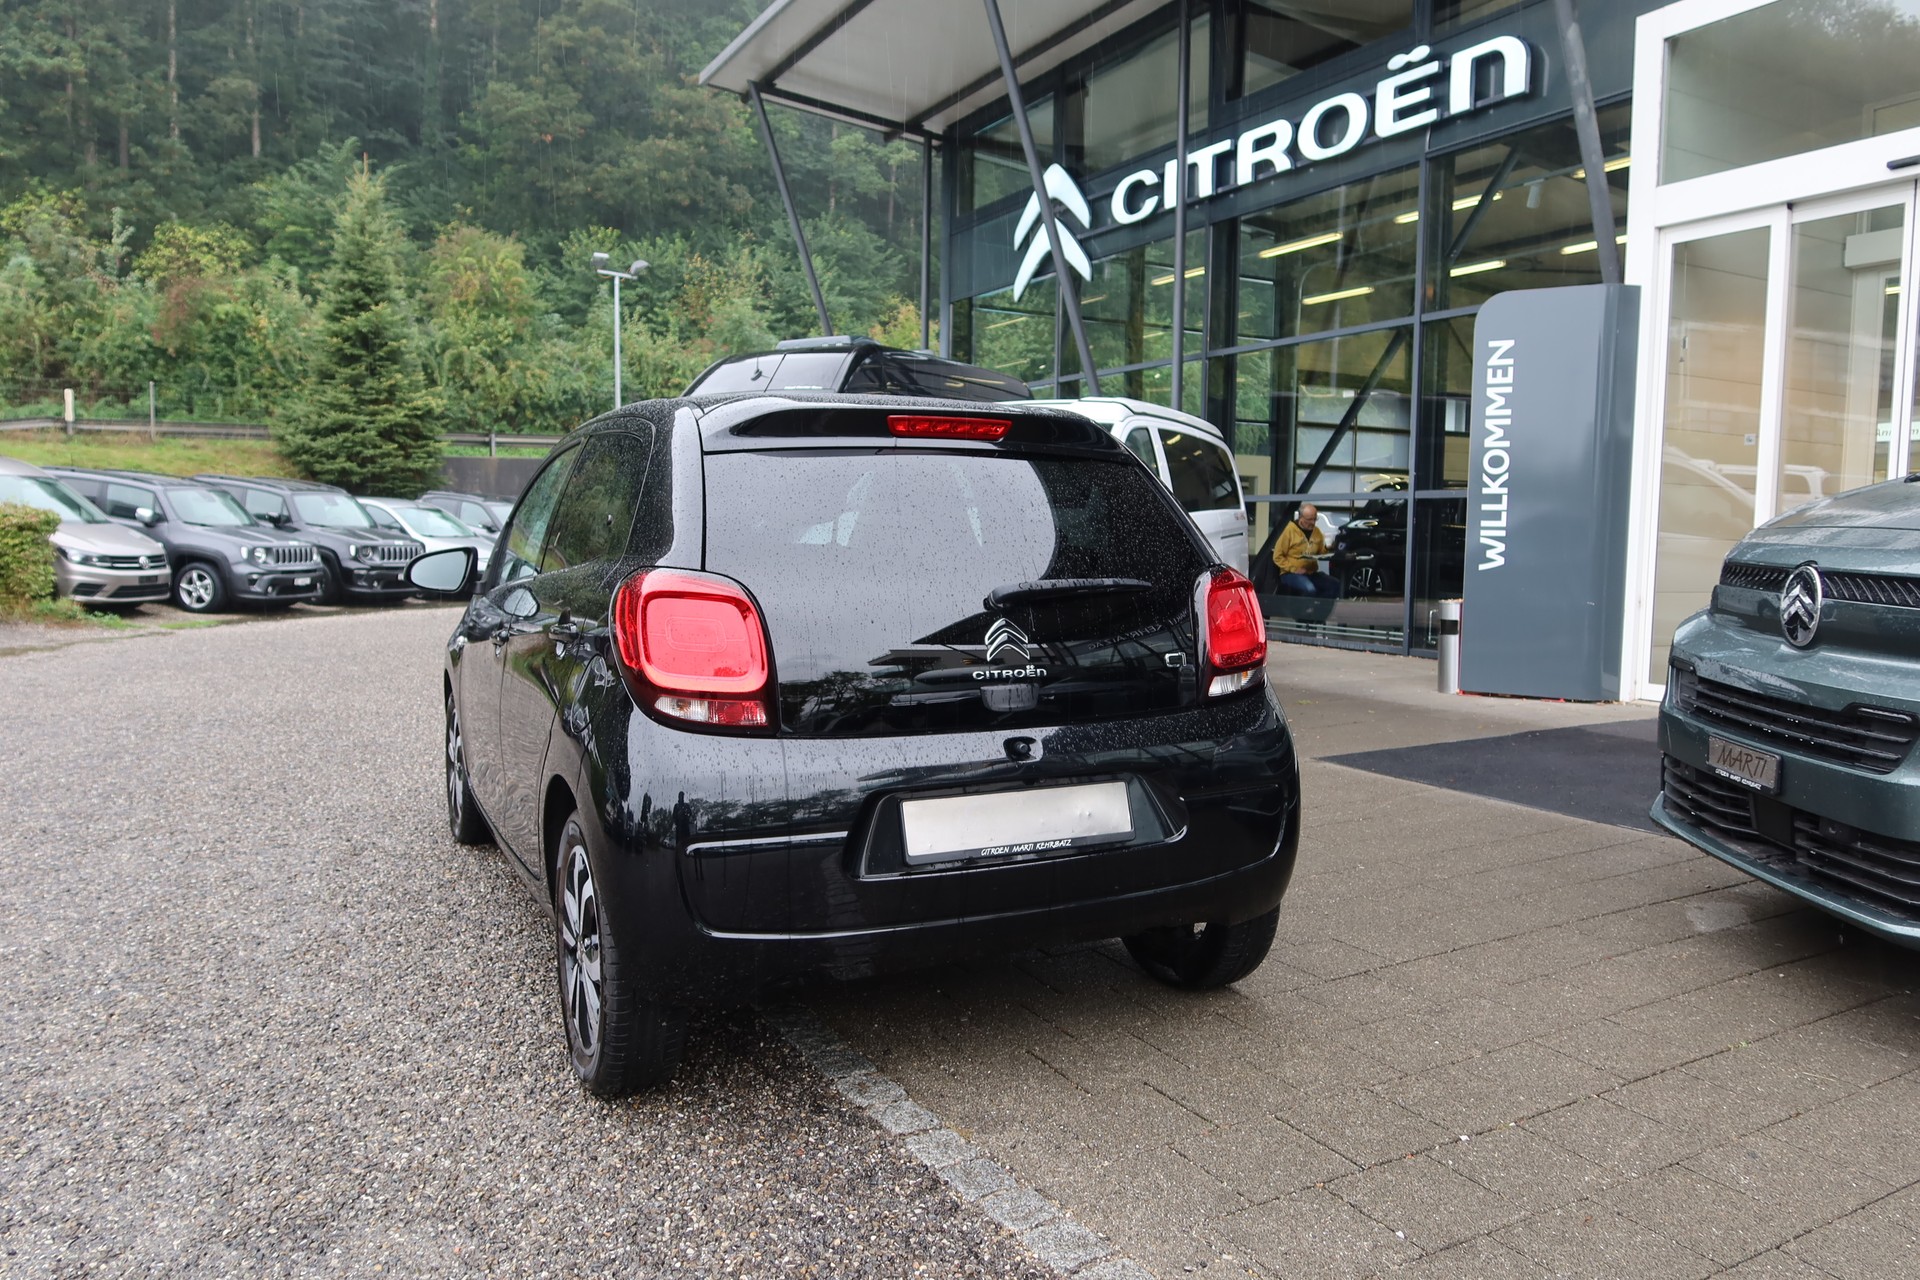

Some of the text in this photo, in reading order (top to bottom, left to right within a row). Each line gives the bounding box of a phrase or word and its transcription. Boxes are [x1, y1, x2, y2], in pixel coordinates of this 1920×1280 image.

[1110, 35, 1531, 226] CITROËN
[1478, 339, 1515, 571] WILLKOMMEN
[972, 664, 1047, 680] CITROËN
[1717, 745, 1767, 778] MARTI
[1012, 843, 1034, 853] MARTI
